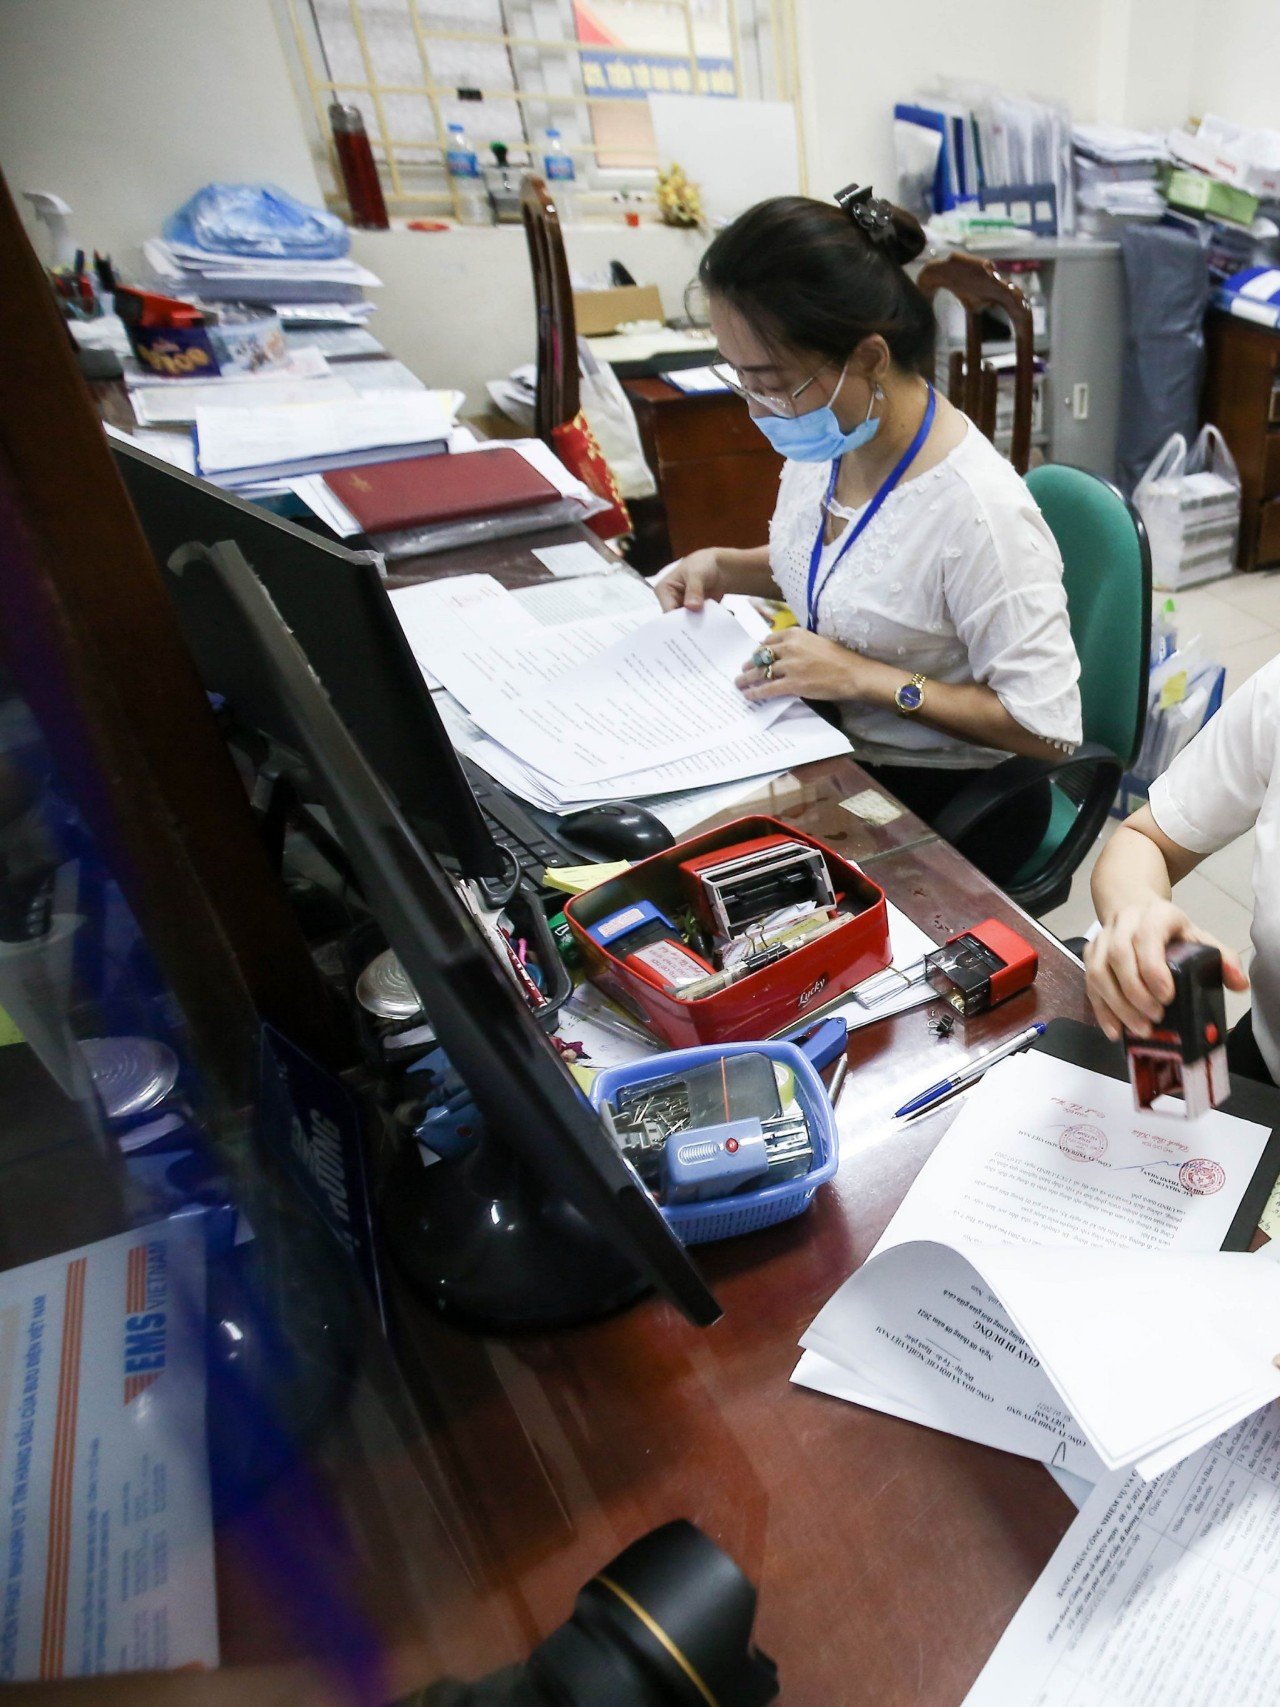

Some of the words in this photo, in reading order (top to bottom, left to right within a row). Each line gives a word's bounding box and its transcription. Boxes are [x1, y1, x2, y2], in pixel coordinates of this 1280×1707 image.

[797, 978, 826, 1007] Lucky
[124, 1312, 167, 1374] EMS
[148, 1239, 168, 1311] VIETNAM
